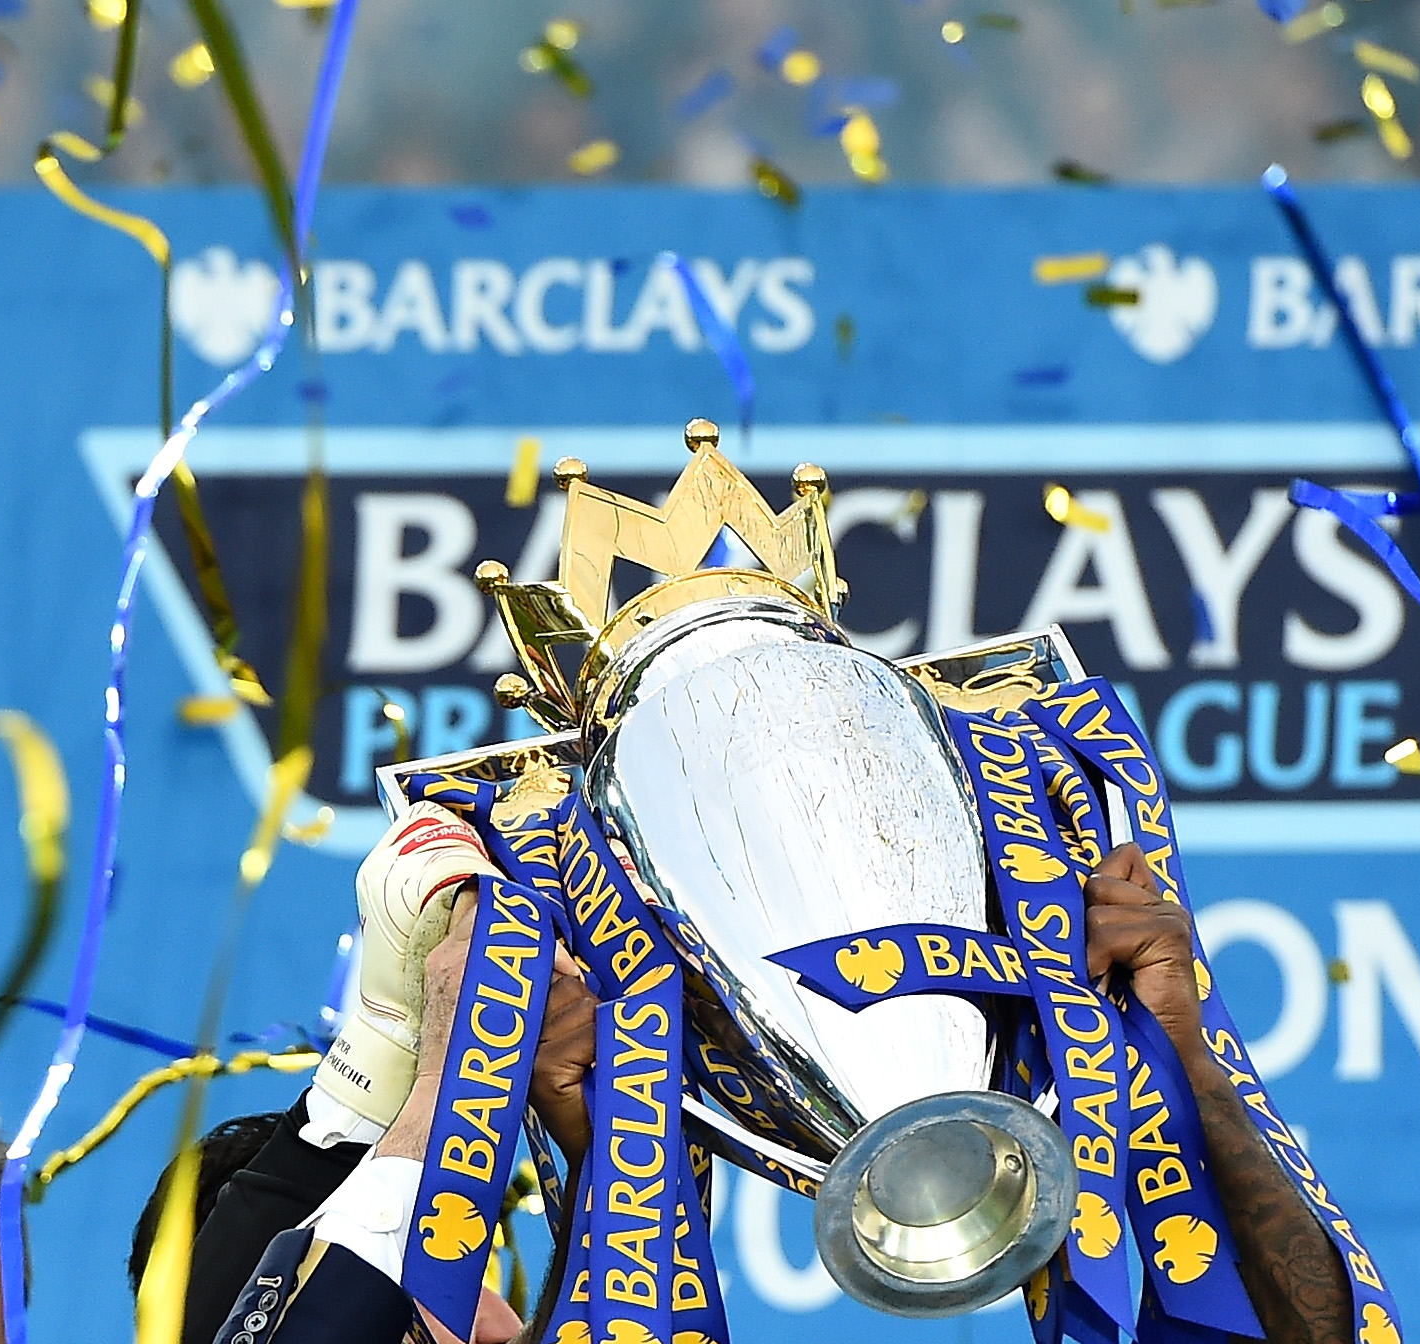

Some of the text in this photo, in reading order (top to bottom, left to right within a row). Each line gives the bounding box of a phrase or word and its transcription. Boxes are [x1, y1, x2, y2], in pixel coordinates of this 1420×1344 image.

[315, 257, 818, 355] BARCLAYS
[440, 882, 541, 1183] BARCLAYS
[606, 1002, 670, 1310] BARCLAYS
[1017, 899, 1119, 1178] BARCLAYS
[1201, 1027, 1384, 1292] BARCLAYS
